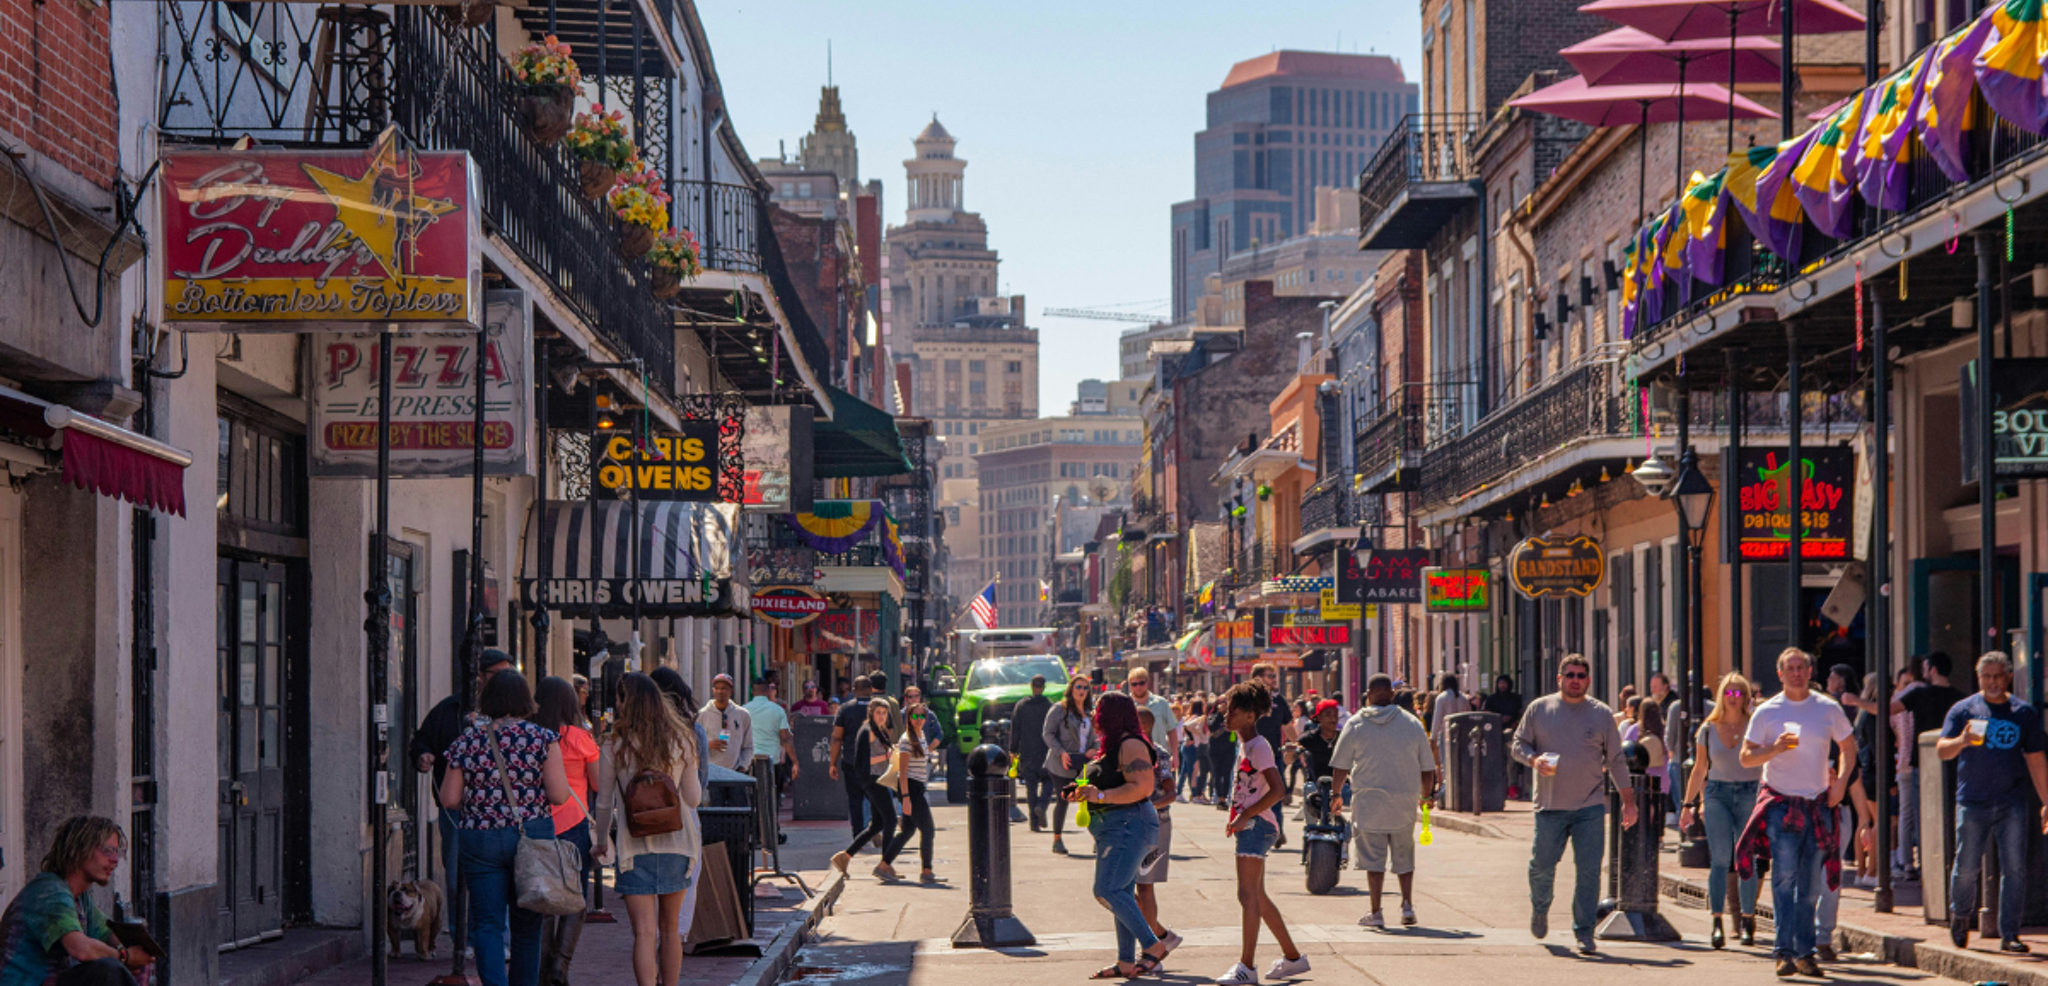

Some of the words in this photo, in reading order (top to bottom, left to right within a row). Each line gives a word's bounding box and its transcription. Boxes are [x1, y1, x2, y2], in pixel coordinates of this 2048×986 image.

[173, 220, 374, 290] Daddy's
[175, 280, 344, 314] Bottomless
[348, 282, 463, 317] Topless
[326, 342, 511, 390] PIZZA
[388, 425, 411, 446] BY
[419, 424, 451, 446] THE
[456, 424, 506, 446] SLCE
[599, 465, 712, 490] OWENS
[1740, 479, 1779, 511] BIG
[1346, 568, 1422, 579] SUTR
[1519, 559, 1600, 578] BANDSTAND
[529, 579, 612, 604] CHRIS
[622, 579, 719, 604] OWENS
[751, 597, 826, 611] DIXIELAND
[1329, 625, 1349, 643] CLUB
